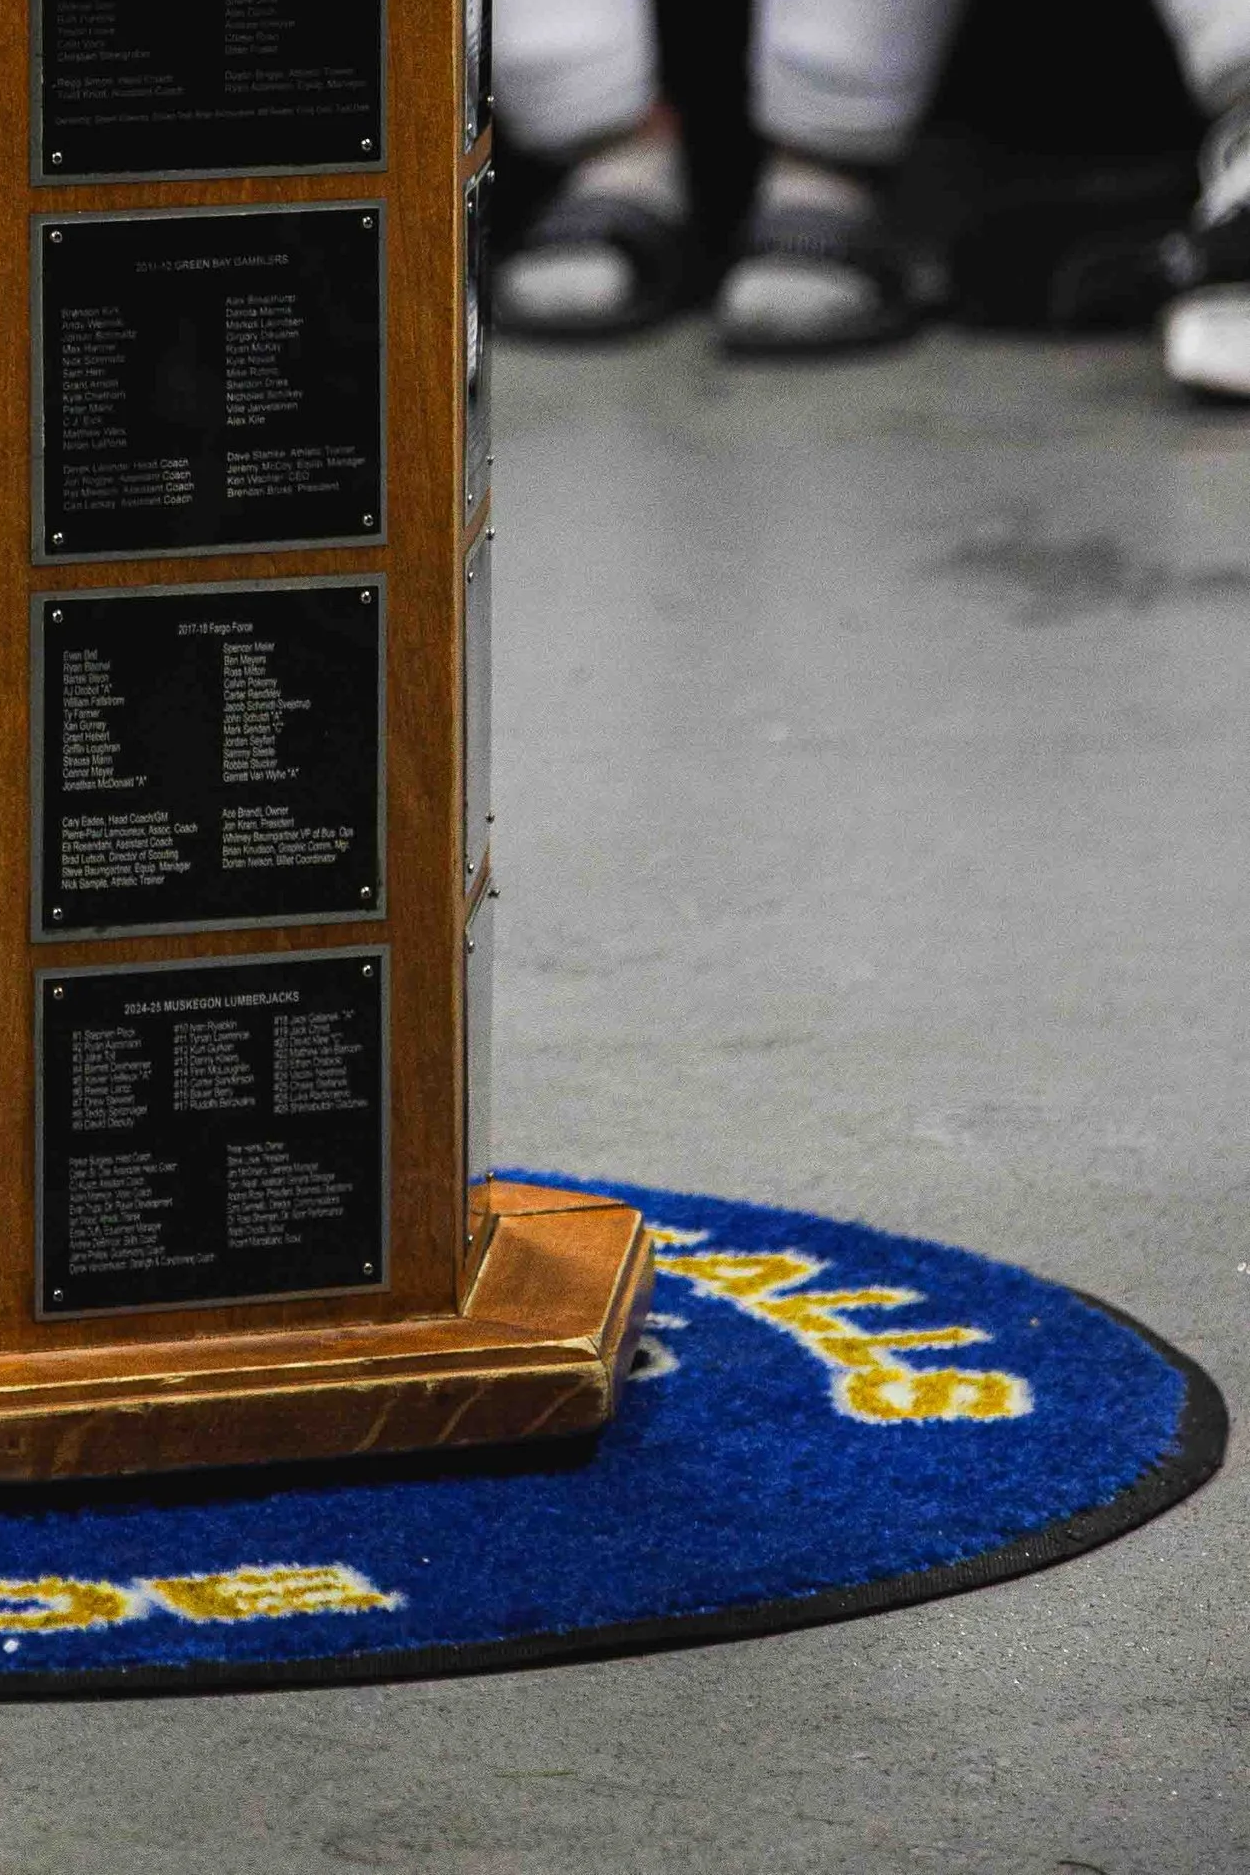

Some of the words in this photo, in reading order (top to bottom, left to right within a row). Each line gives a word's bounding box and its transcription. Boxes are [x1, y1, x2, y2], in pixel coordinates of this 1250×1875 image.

[124, 1001, 161, 1014] 2024-25
[163, 996, 221, 1011] MUSKEGON
[224, 990, 299, 1007] LUMBERJACKS
